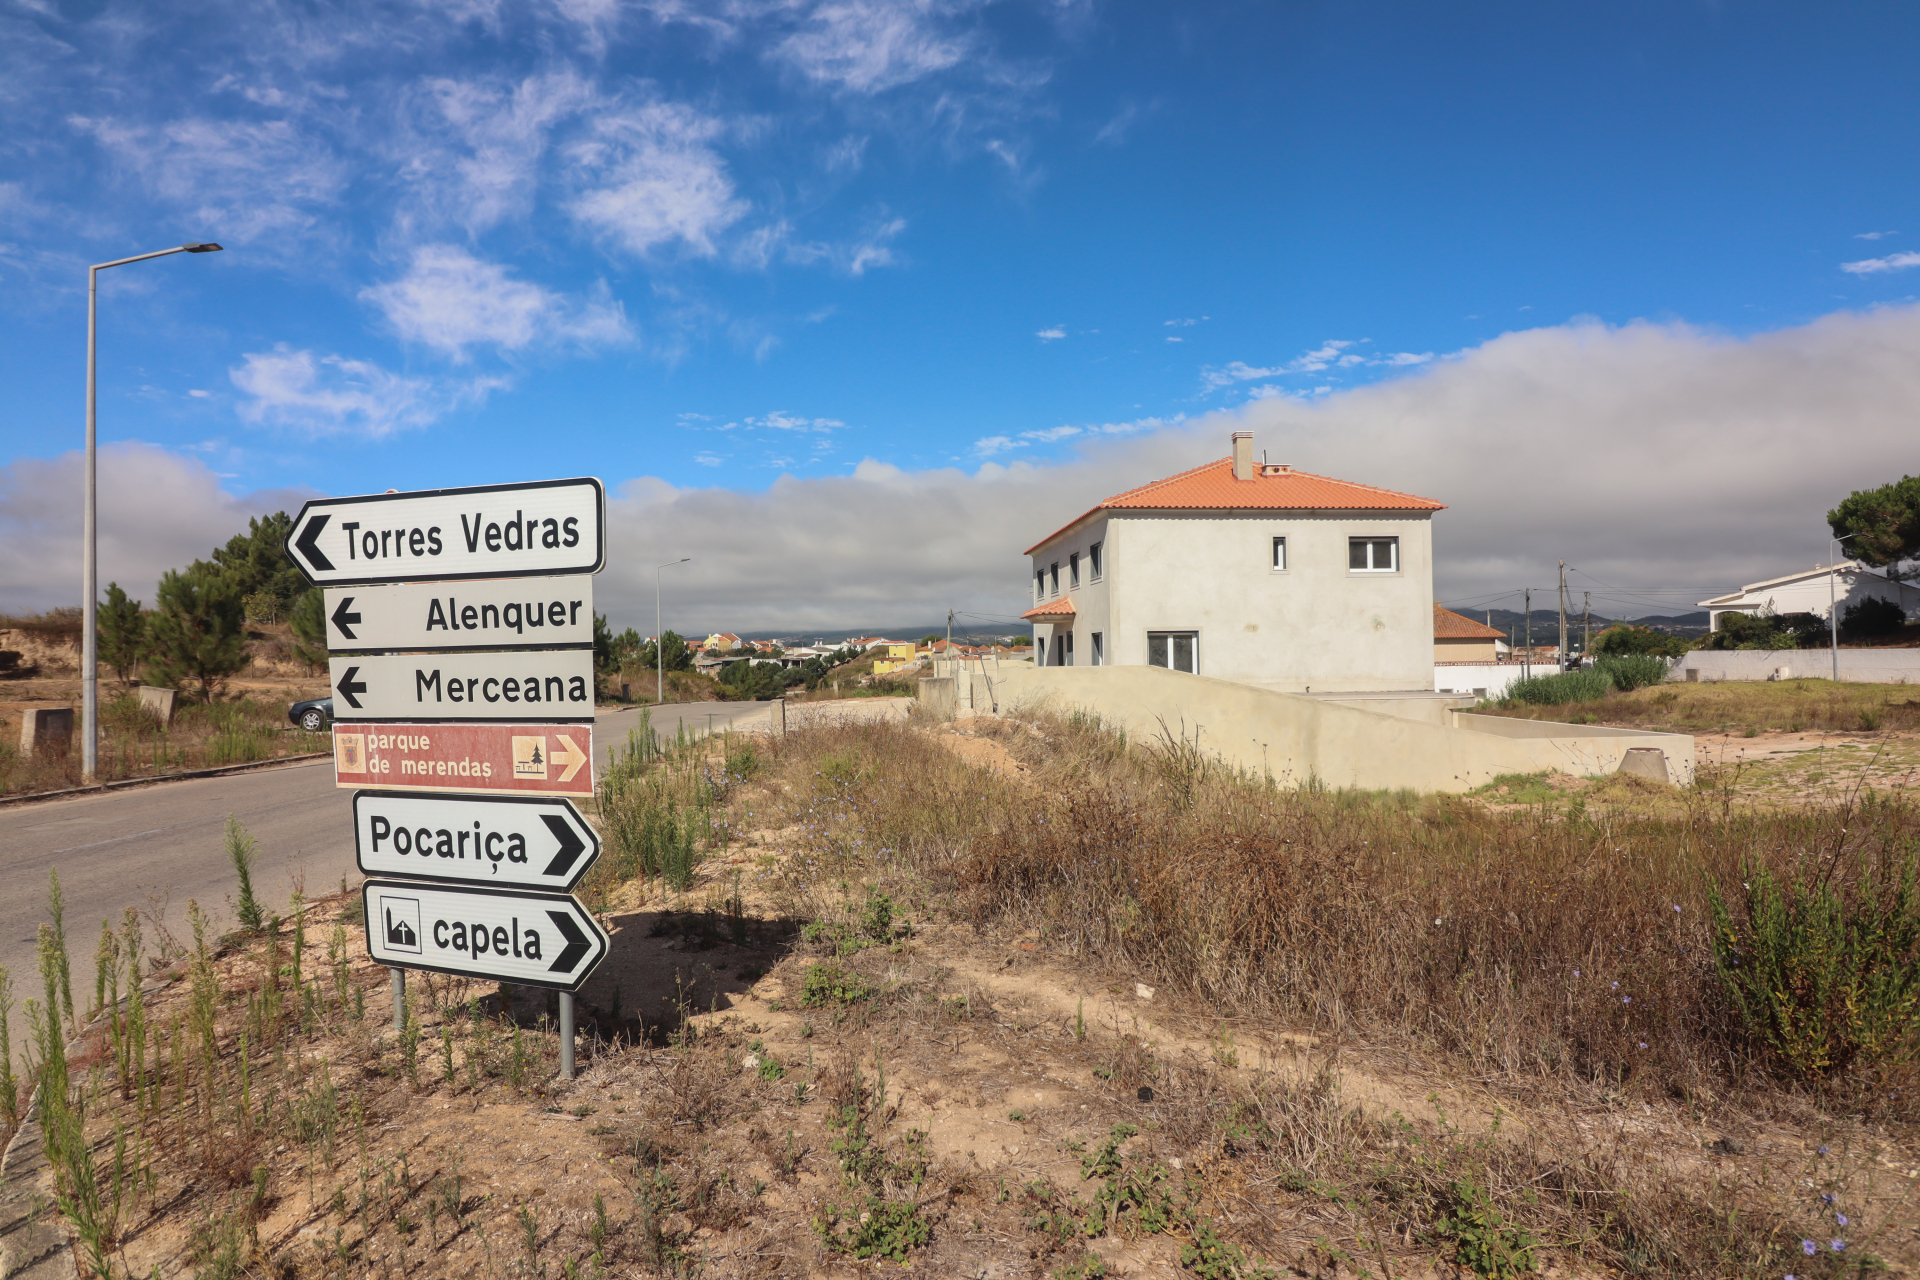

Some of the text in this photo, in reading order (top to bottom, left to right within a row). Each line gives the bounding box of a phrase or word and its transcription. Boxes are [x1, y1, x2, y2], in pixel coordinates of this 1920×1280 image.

[342, 510, 580, 560] Torres Vedras
[426, 597, 583, 635] Alenquer
[415, 669, 588, 703] Merceana
[367, 734, 430, 753] parque
[369, 755, 390, 774] de
[401, 757, 492, 777] merendas
[370, 815, 528, 875] Pocariça
[433, 917, 543, 961] capela
